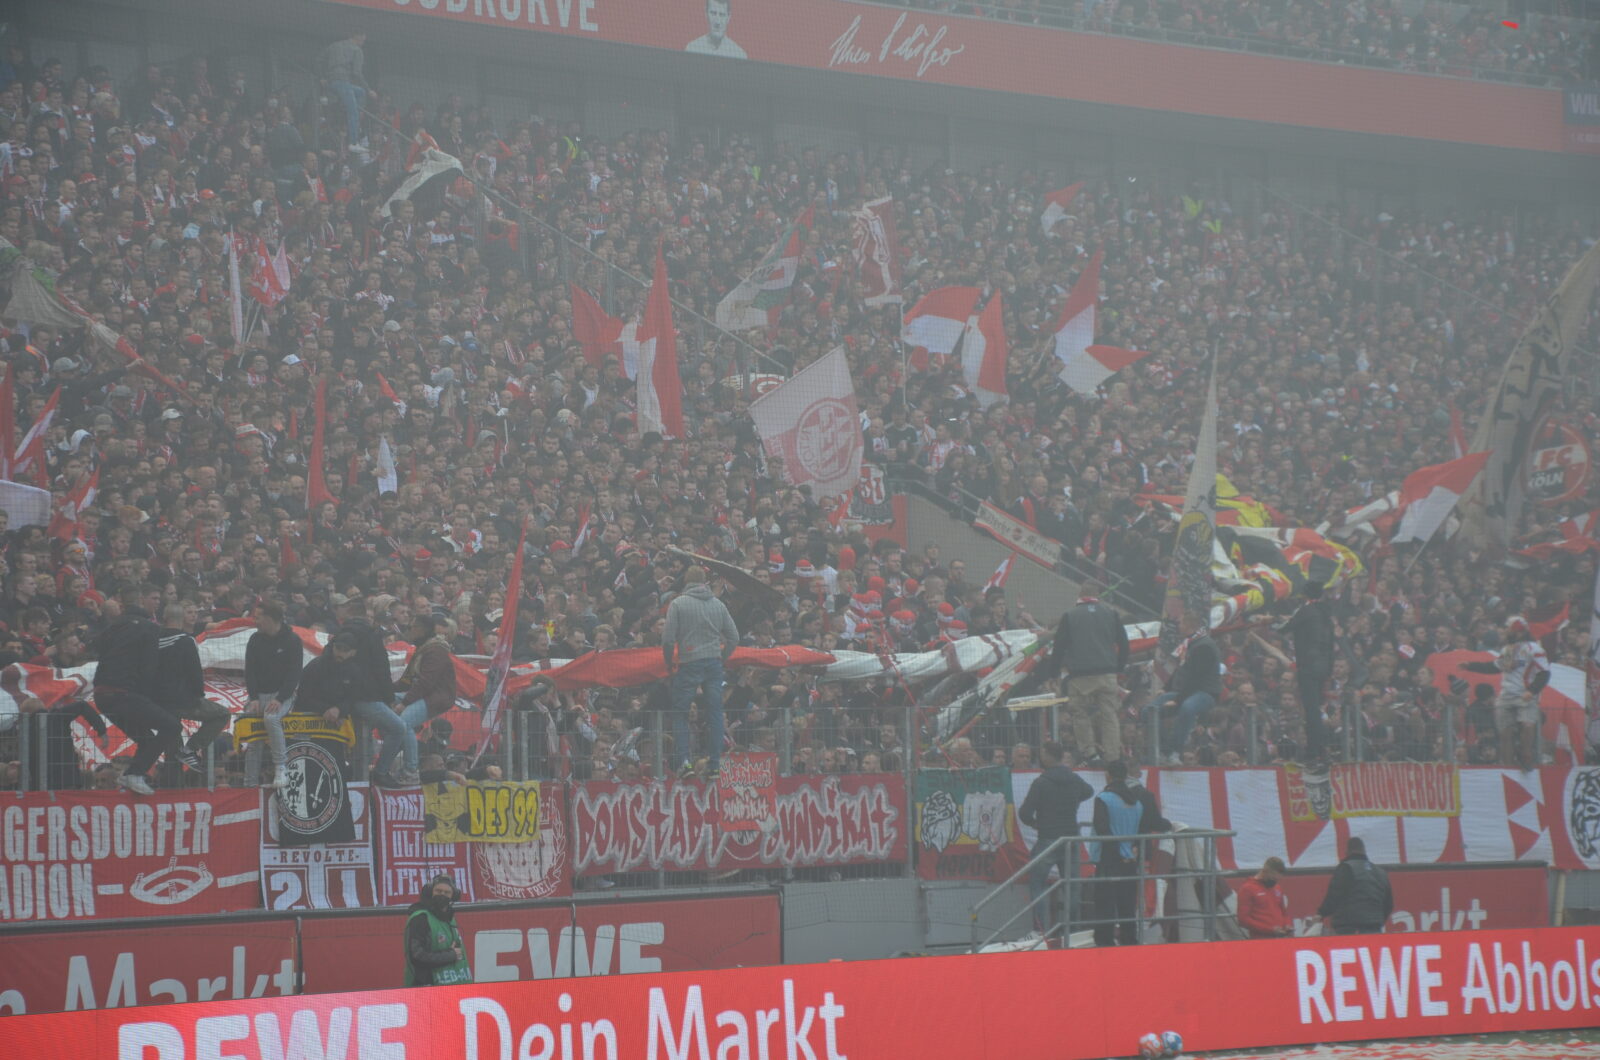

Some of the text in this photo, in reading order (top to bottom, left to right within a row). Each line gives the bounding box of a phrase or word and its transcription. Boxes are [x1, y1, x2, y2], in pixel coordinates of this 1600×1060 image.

[467, 785, 511, 837] DES
[513, 787, 539, 837] 99
[1330, 762, 1457, 812] STADIONVERBOT
[4, 802, 213, 862] GERSDORFER
[280, 848, 354, 863] REVOLTE
[1381, 886, 1488, 933] arkt
[474, 921, 665, 983] EWE
[1296, 944, 1449, 1025] REWE
[458, 991, 619, 1060] Dein
[646, 979, 848, 1060] Markt
